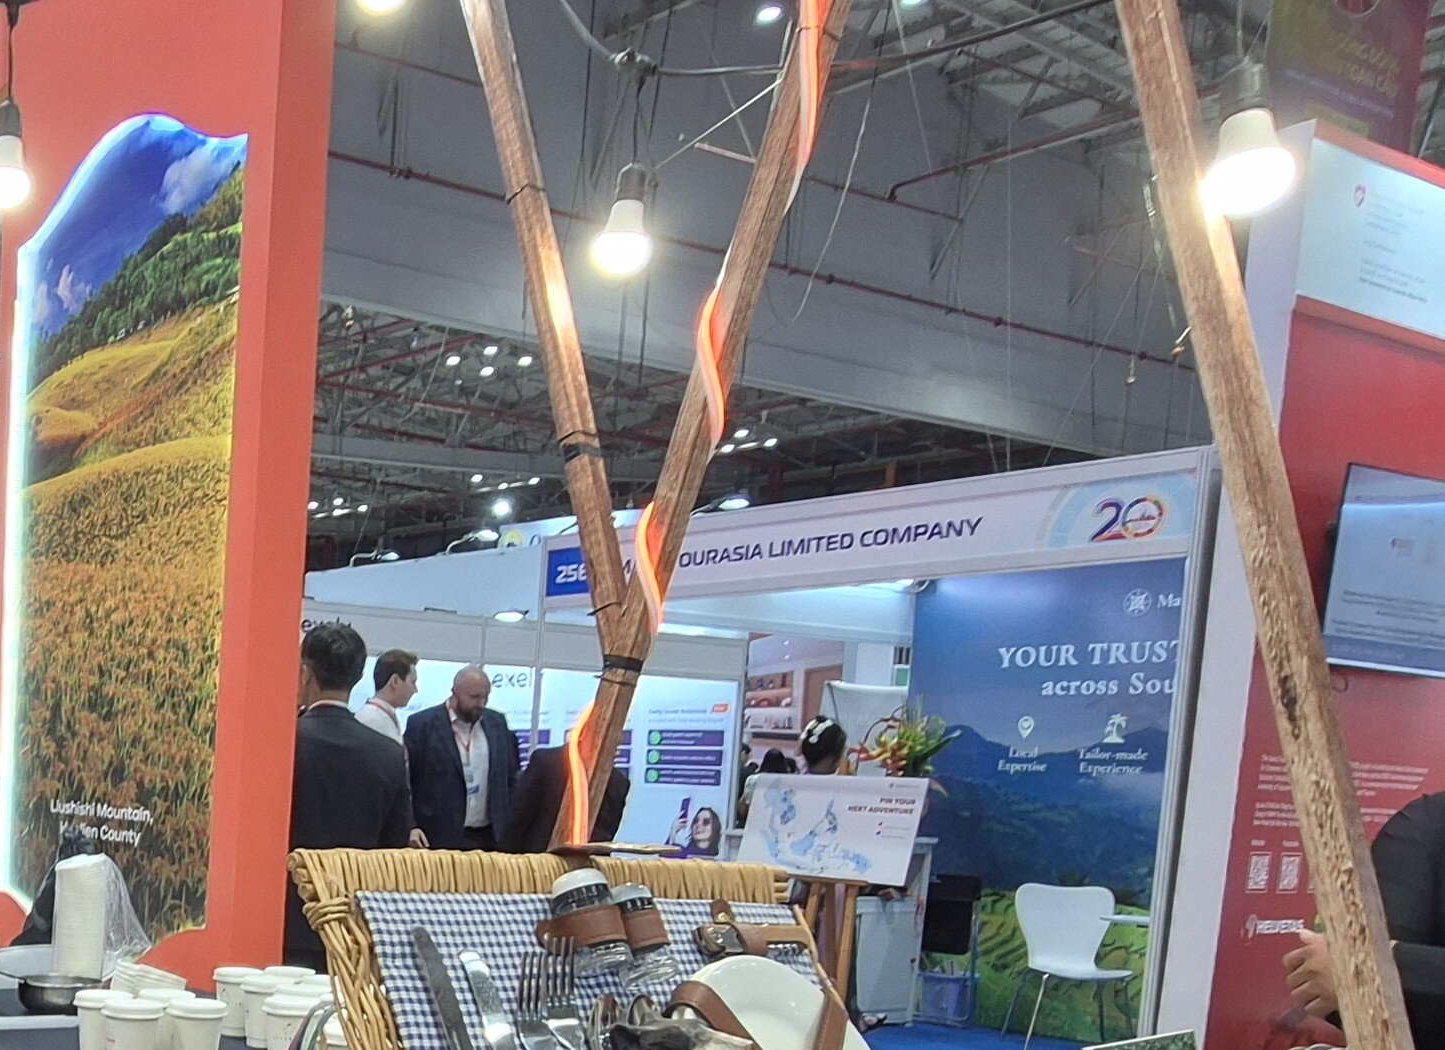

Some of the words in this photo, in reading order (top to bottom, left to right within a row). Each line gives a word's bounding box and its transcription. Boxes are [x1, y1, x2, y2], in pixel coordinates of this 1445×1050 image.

[678, 542, 764, 569] OURASIA
[767, 532, 854, 559] LIMITED
[859, 515, 985, 549] COMPANY
[997, 645, 1080, 669] YOUR
[1041, 678, 1119, 696] across
[1007, 746, 1039, 759] Local
[1077, 747, 1149, 762] Tailor-made
[997, 760, 1048, 774] Expertise
[1078, 762, 1144, 776] Experience
[894, 798, 916, 806] YOUR
[96, 802, 154, 827] Mountain,
[847, 805, 867, 813] NEXT
[867, 806, 915, 815] ADVENTURE
[59, 821, 99, 840] Hlien
[100, 825, 143, 848] County
